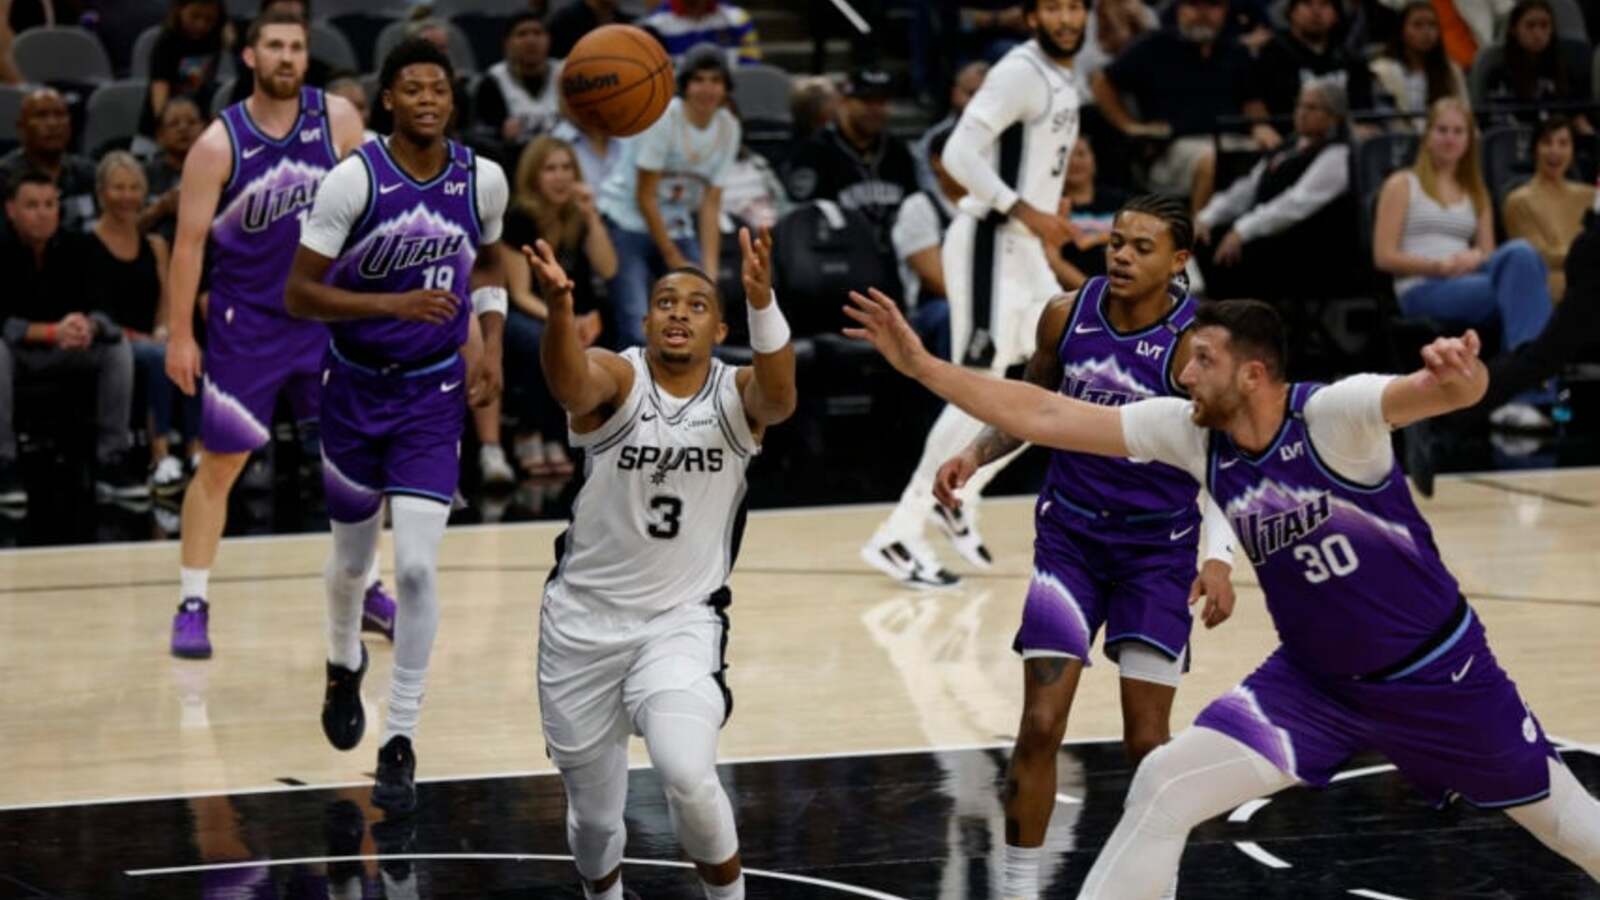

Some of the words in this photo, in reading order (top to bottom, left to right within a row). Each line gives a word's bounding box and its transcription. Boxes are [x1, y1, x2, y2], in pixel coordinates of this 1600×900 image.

[443, 181, 467, 196] LVT
[359, 233, 465, 279] UTAH
[421, 264, 455, 293] 19
[1136, 339, 1165, 360] LVT
[617, 445, 724, 486] SPURS
[648, 495, 683, 540] 3
[1233, 490, 1332, 566] UTAH
[1293, 534, 1359, 583] 30
